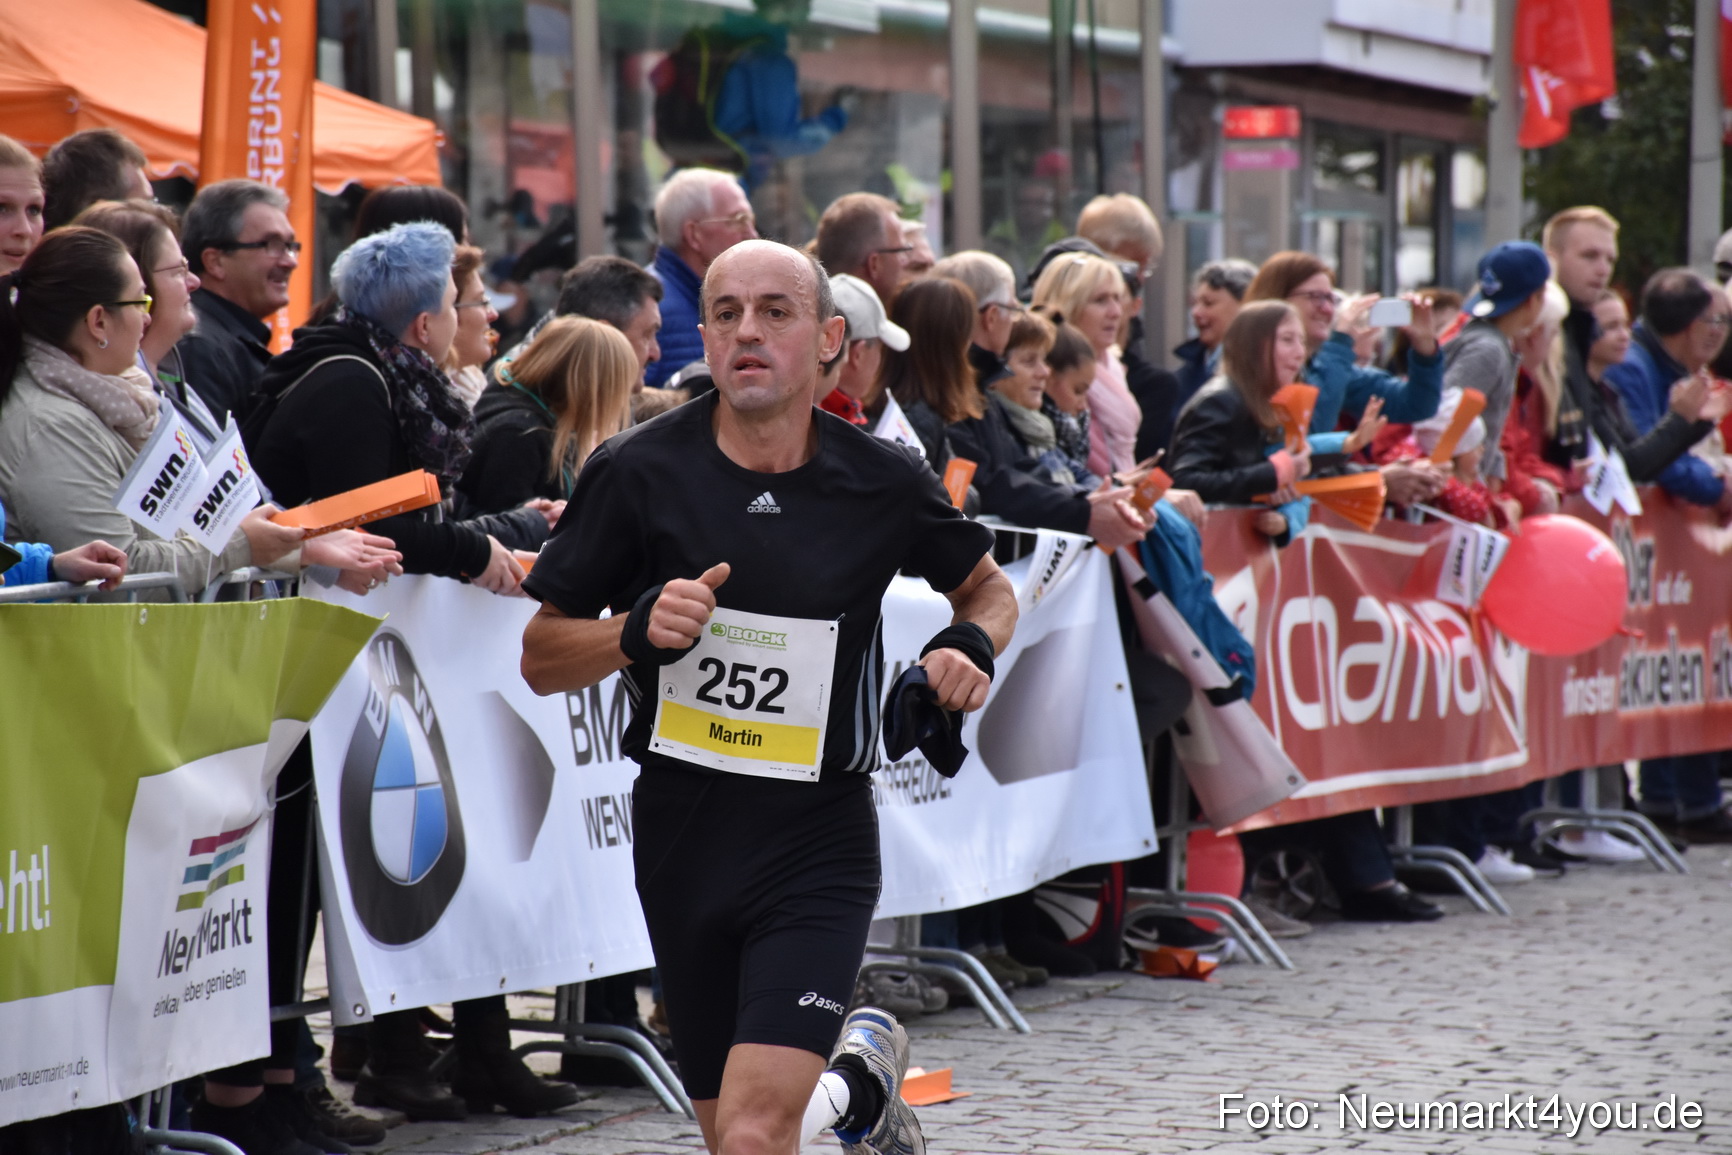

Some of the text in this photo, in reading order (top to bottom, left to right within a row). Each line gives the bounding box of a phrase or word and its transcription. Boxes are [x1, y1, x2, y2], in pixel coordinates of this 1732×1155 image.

[247, 38, 266, 178] PRINT
[140, 453, 186, 517] swn
[154, 481, 183, 523] stadtwerke
[193, 470, 239, 531] swn
[747, 504, 781, 513] adidas
[206, 499, 233, 537] stadtwerke
[728, 625, 787, 647] BOCK
[696, 657, 789, 714] 252
[565, 677, 634, 767] BM
[709, 722, 762, 747] Martin
[581, 792, 632, 850] WEN
[0, 844, 51, 934] ht!
[815, 997, 845, 1015] asics
